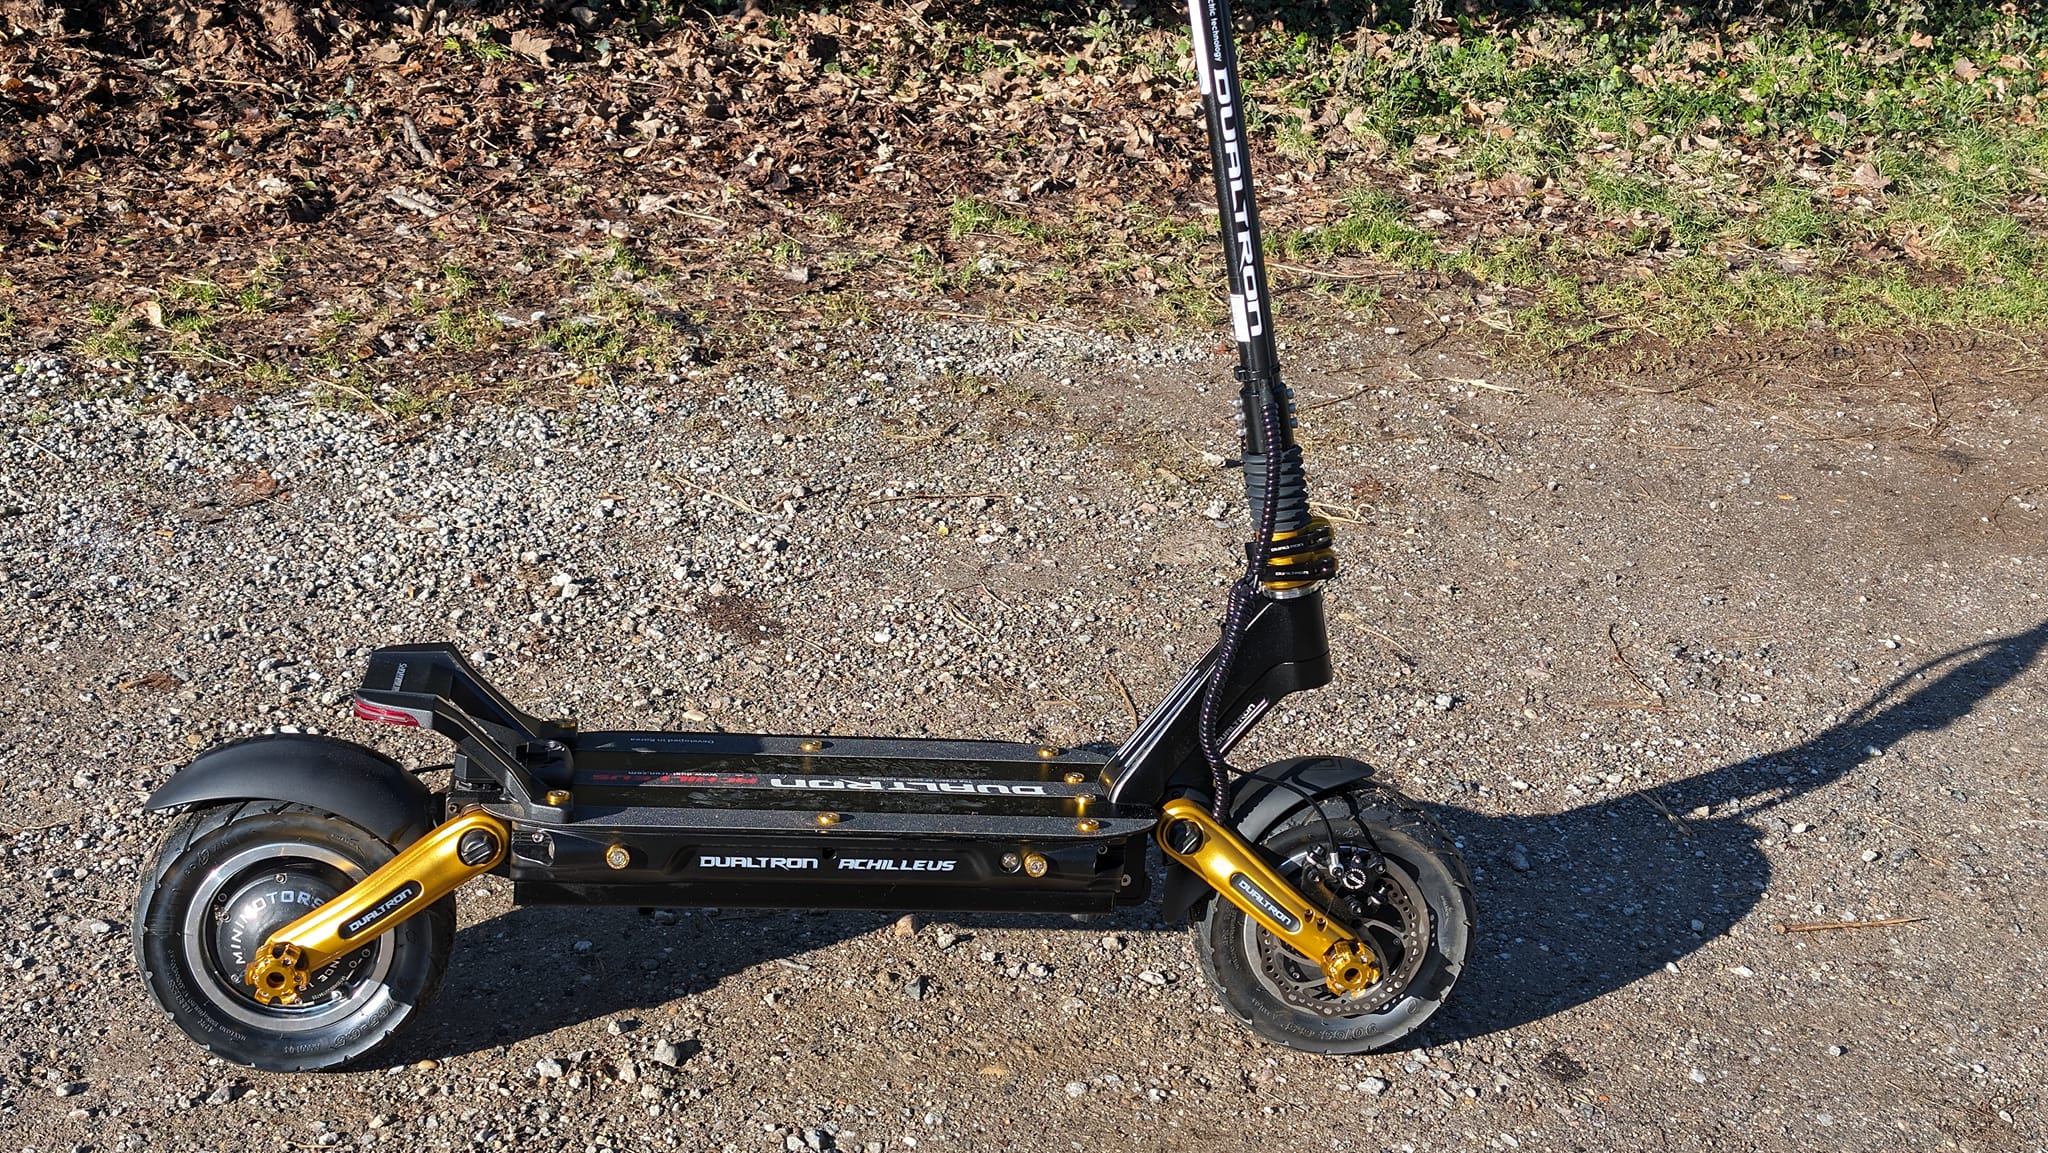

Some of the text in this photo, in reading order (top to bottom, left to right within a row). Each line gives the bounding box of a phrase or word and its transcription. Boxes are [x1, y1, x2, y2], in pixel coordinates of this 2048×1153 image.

[1211, 18, 1222, 62] technology
[1213, 66, 1263, 338] DUALTRON
[770, 777, 1047, 796] DUALTRON
[700, 855, 957, 872] DUALTRON ACHILLEUS
[349, 888, 413, 932] DUALTRON
[1238, 879, 1291, 926] DUALTRON
[230, 890, 325, 965] MINIMOTORS
